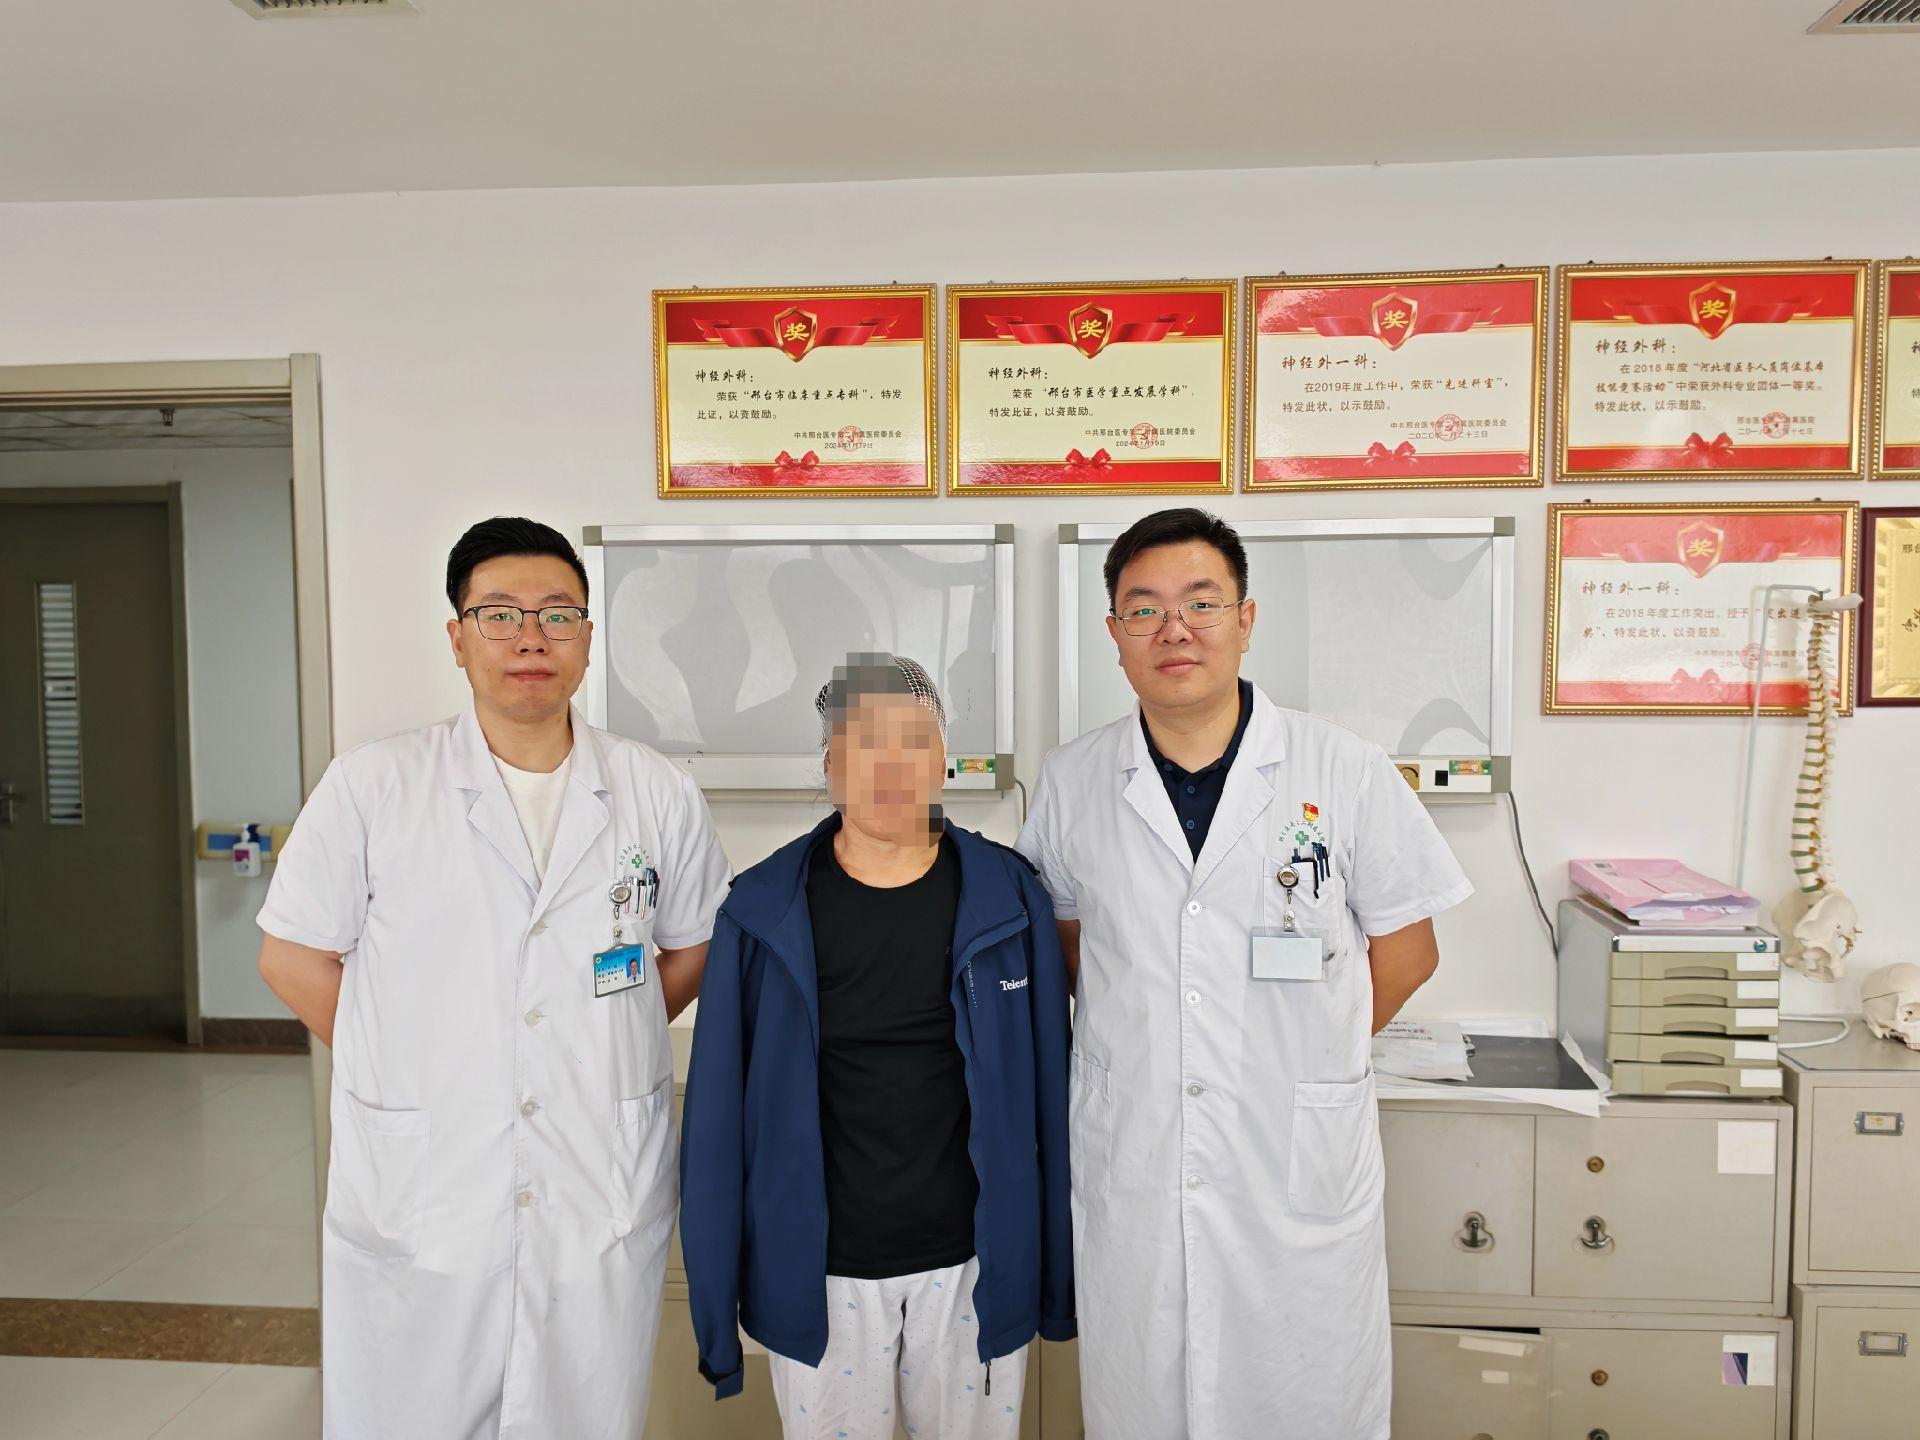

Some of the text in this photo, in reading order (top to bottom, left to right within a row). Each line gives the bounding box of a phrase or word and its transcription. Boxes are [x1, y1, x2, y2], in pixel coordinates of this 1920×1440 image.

[1381, 309, 1408, 329] 奖
[1699, 299, 1728, 319] 奖
[782, 322, 810, 342] 奖
[1077, 318, 1105, 339] 奖
[1687, 538, 1714, 556] 奖
